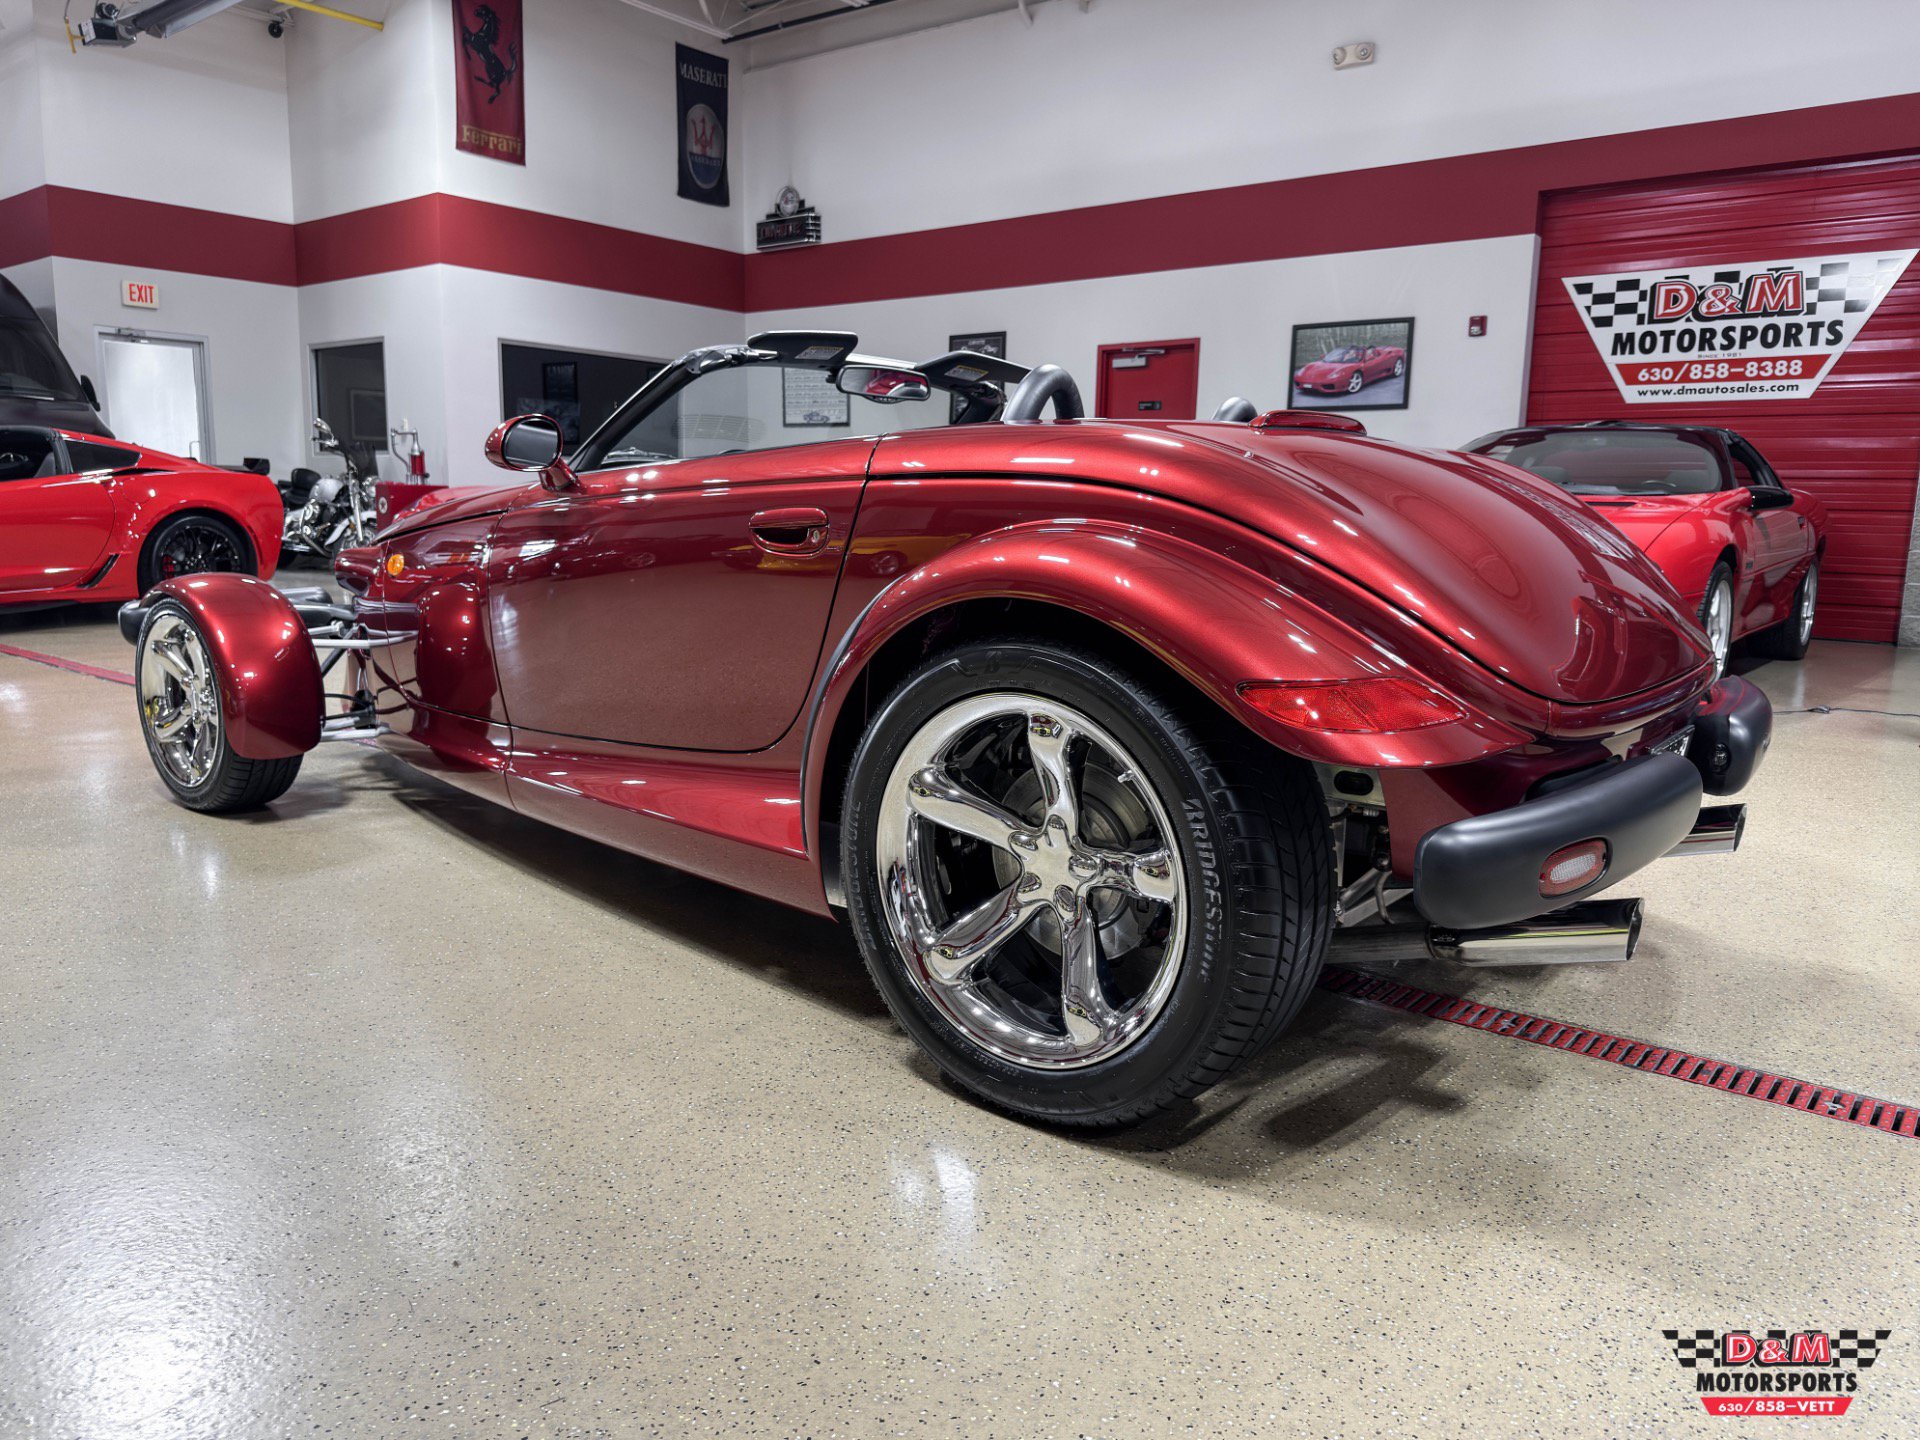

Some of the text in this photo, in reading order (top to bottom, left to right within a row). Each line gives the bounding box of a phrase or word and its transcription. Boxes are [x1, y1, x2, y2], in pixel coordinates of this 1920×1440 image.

[679, 61, 727, 89] MASERATI
[462, 125, 523, 156] Ferrari
[128, 283, 155, 304] EXIT
[1651, 270, 1804, 321] D&M
[1611, 320, 1844, 356] MOTORSPORTS
[1637, 359, 1803, 382] 630/858-8388
[1637, 383, 1800, 397] www.dmautosales.com
